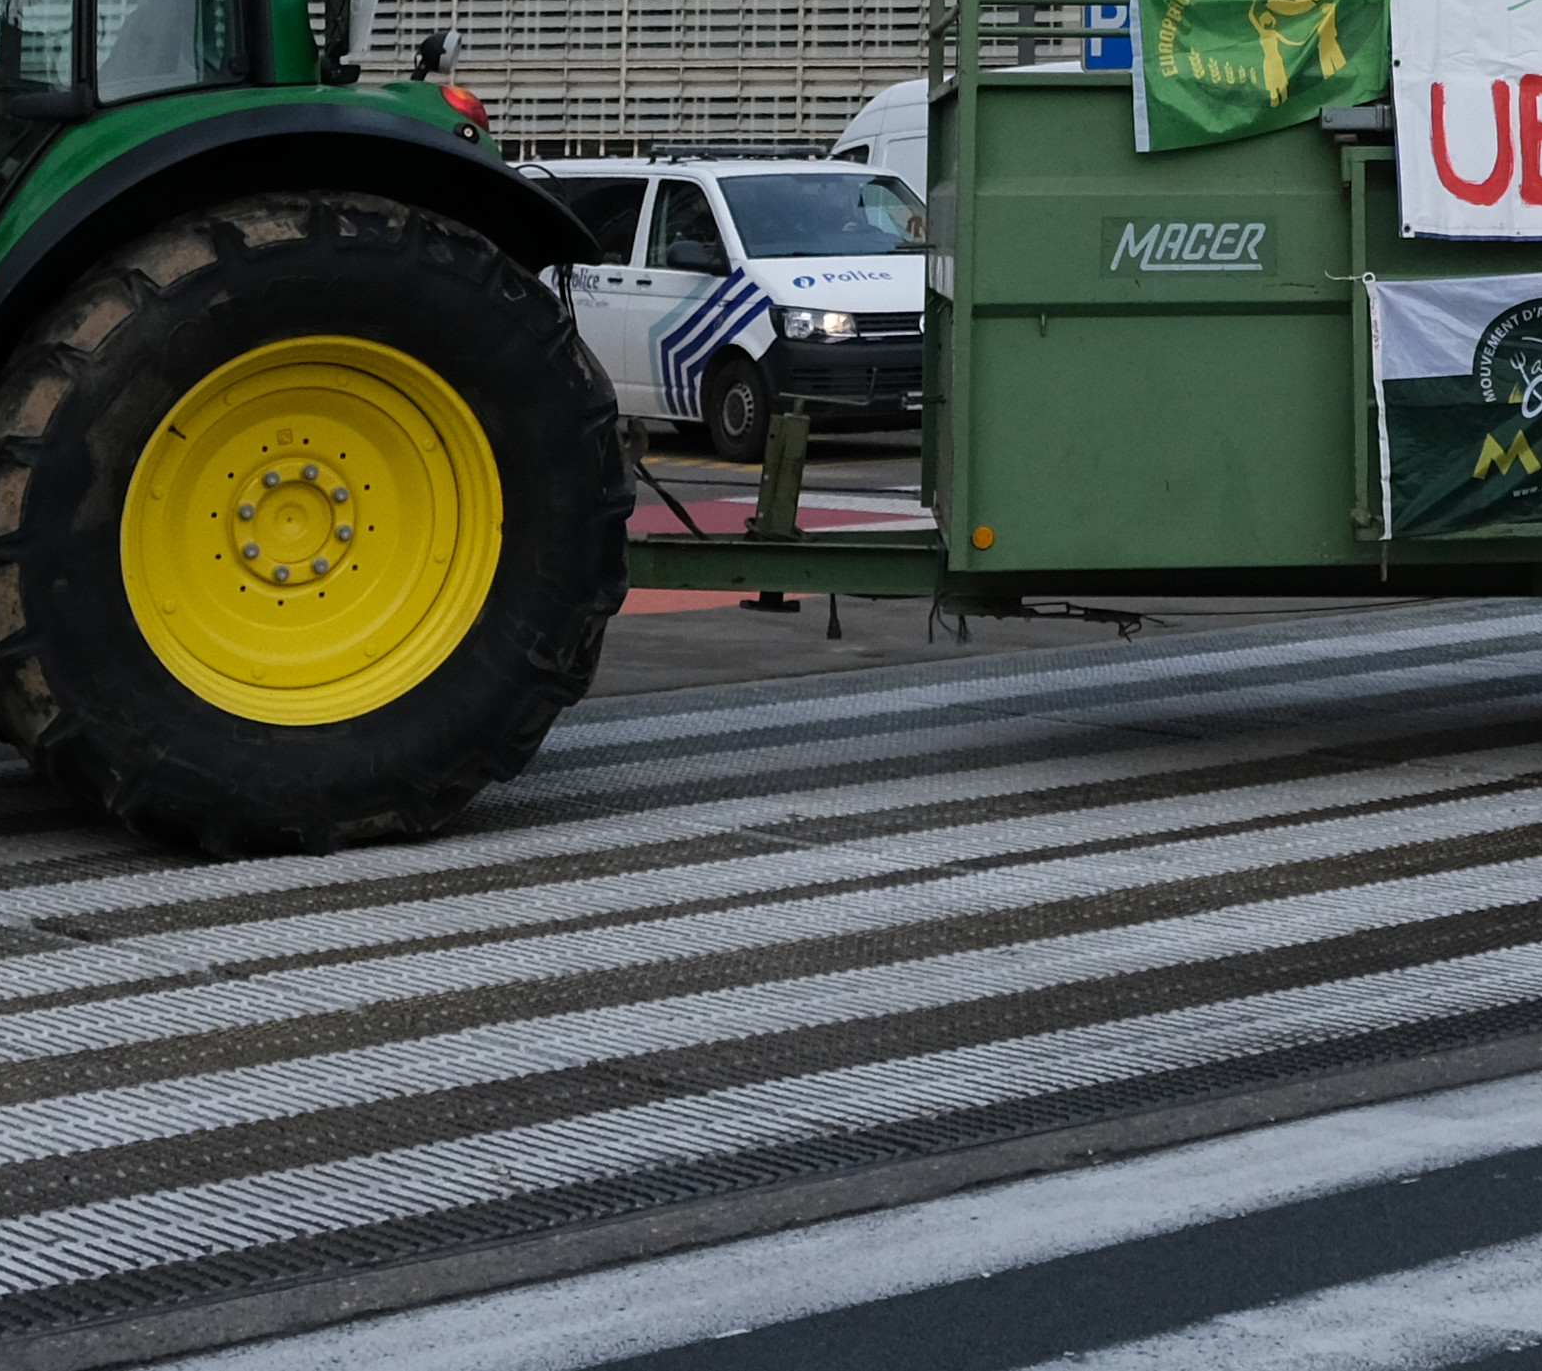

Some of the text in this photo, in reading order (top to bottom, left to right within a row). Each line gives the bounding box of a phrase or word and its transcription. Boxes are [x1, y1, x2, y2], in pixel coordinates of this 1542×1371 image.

[570, 267, 600, 290] olice
[822, 268, 892, 284] Police
[1480, 314, 1520, 403] MOUVEMENT
